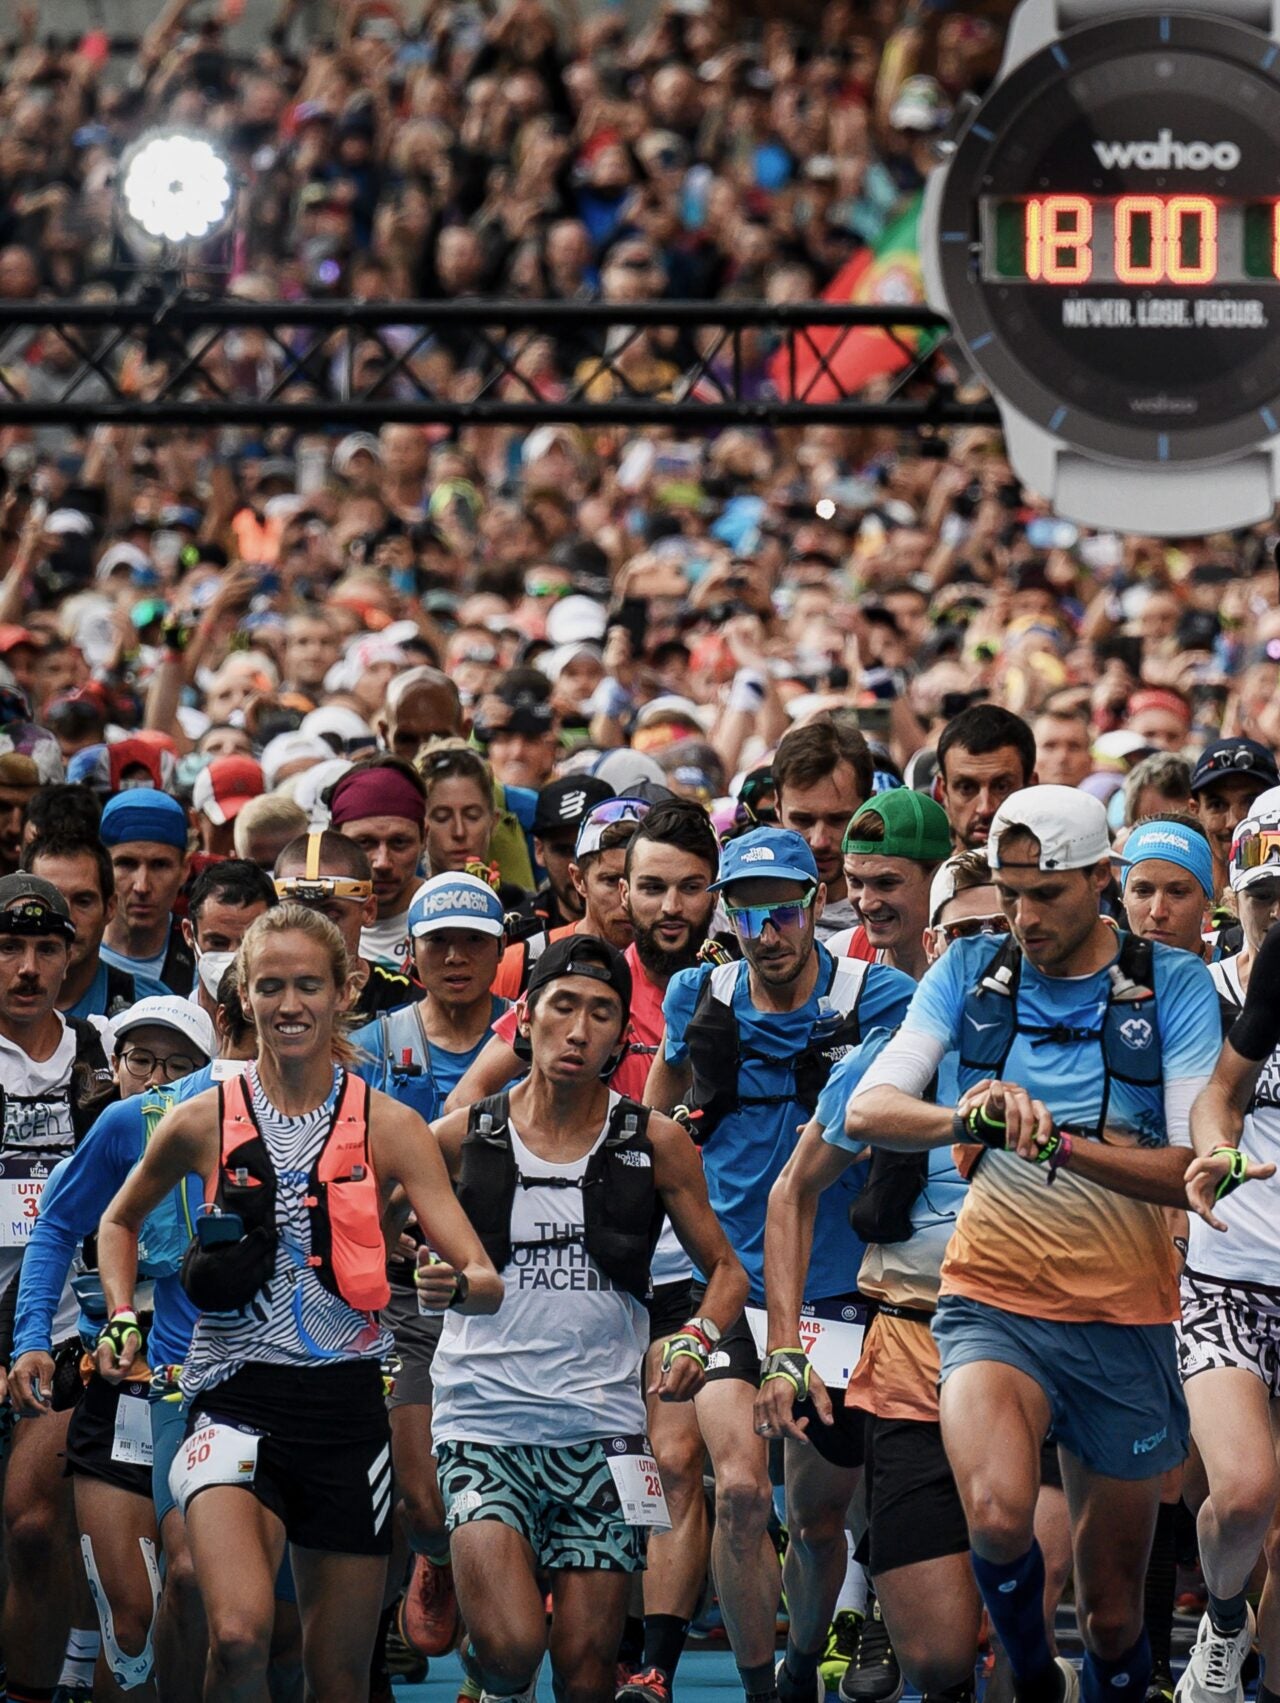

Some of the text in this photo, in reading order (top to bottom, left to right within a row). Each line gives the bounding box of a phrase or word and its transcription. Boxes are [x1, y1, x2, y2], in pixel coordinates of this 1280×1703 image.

[1093, 128, 1241, 170] wahoo
[1025, 195, 1092, 283] 18
[1115, 195, 1217, 283] 00
[423, 891, 469, 916] HOKA
[470, 892, 487, 902] ONE
[470, 901, 488, 913] ONE
[5, 1123, 46, 1142] ACE
[512, 1246, 586, 1267] ORTH
[519, 1268, 586, 1291] FACE
[799, 1320, 821, 1334] MB
[801, 1336, 817, 1354] 7
[187, 1443, 211, 1471] 50
[645, 1475, 662, 1497] 28
